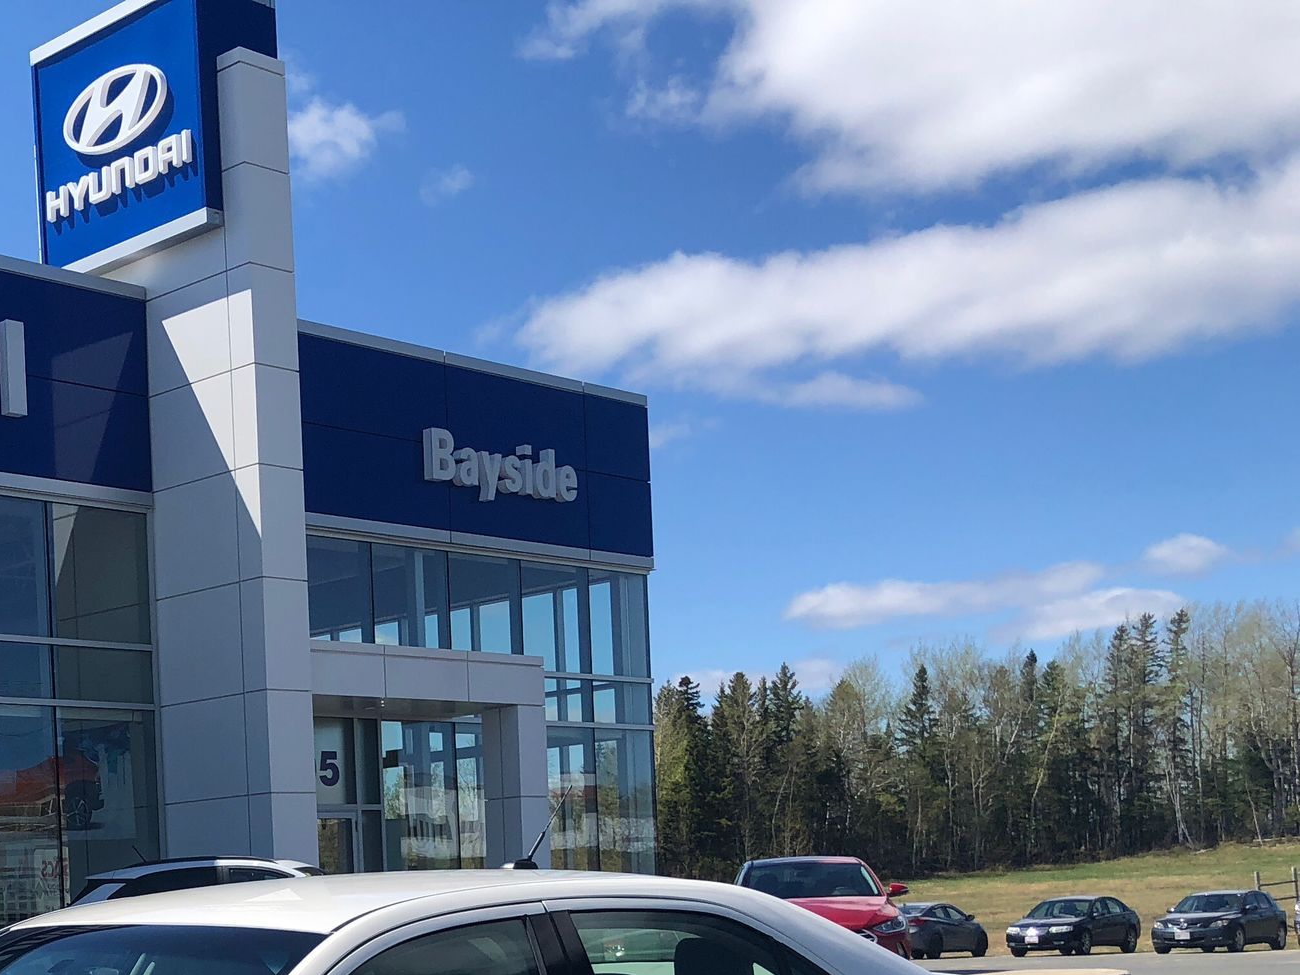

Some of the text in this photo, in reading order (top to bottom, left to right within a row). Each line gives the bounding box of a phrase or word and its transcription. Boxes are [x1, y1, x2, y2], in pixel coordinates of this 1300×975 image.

[46, 129, 193, 223] HYUNDAI
[423, 427, 578, 502] Bayside
[314, 751, 341, 787] 5
